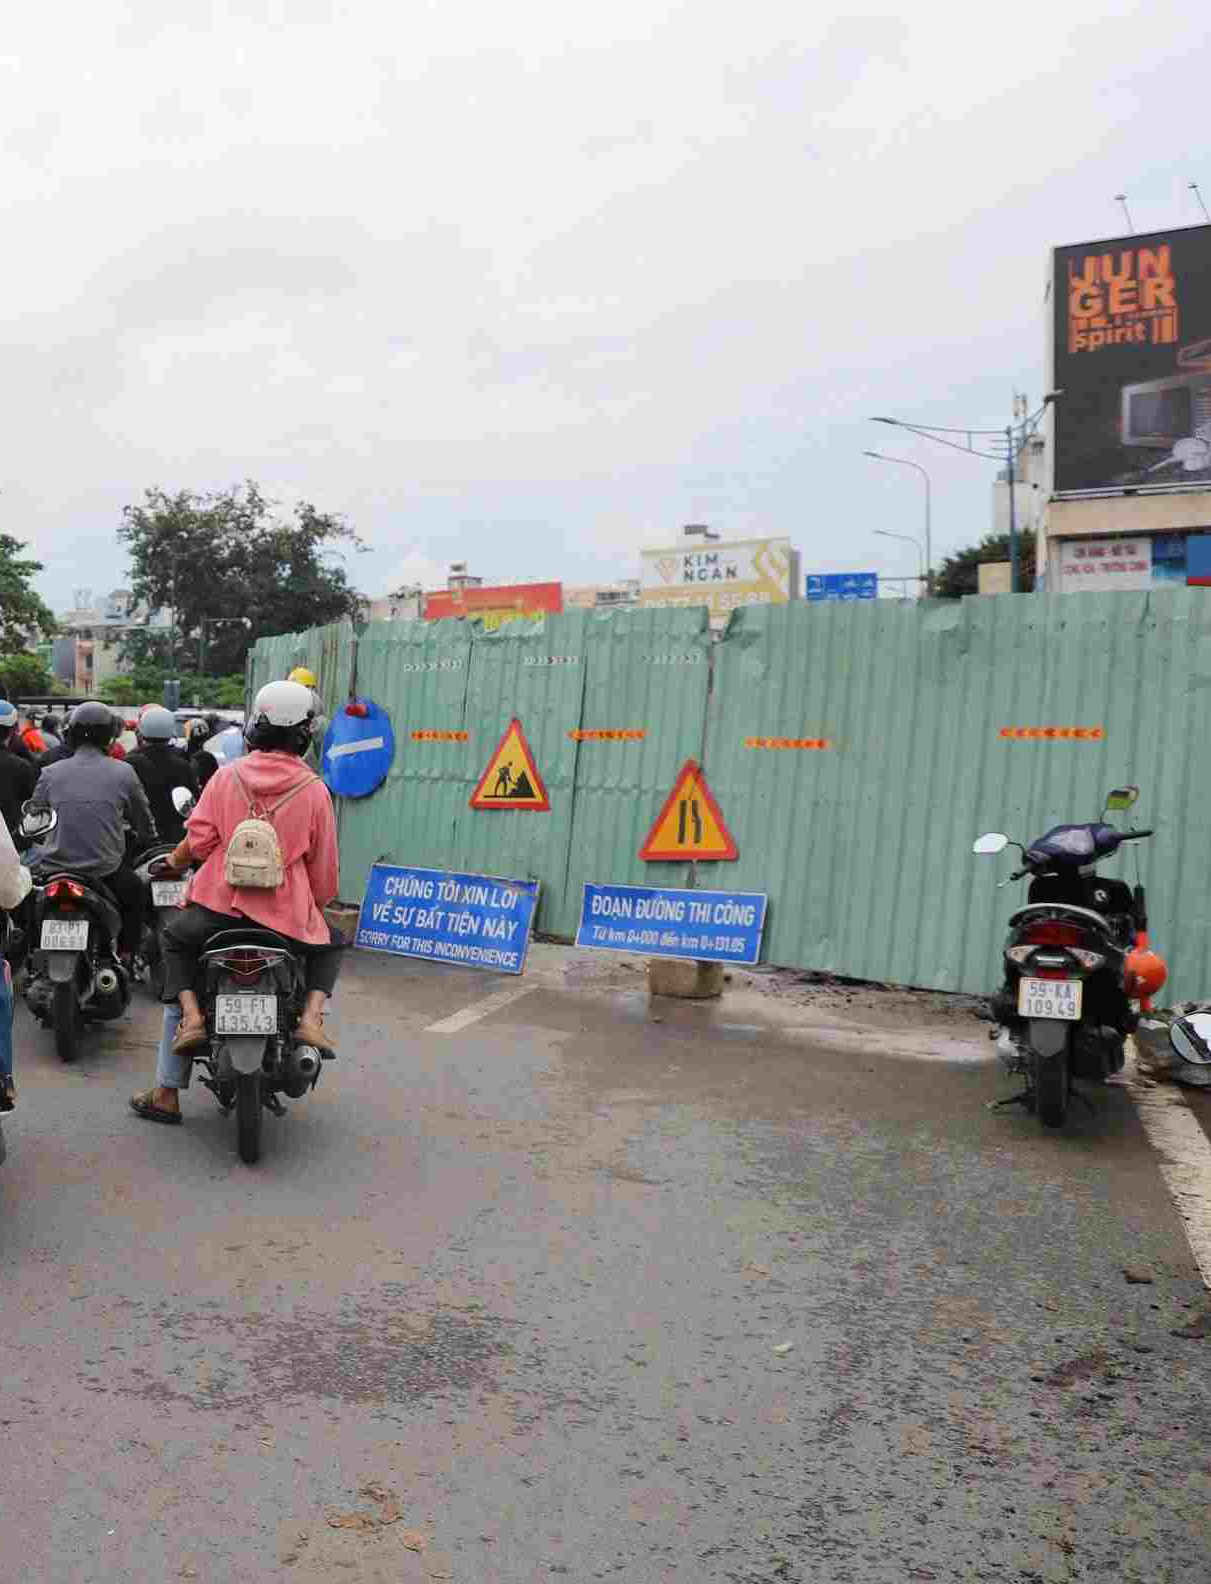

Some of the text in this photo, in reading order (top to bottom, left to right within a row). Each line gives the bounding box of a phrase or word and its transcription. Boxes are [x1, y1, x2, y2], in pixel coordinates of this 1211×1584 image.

[1069, 272, 1176, 317] GER
[683, 552, 719, 567] KIM
[384, 874, 434, 899] CHÚNG
[461, 885, 488, 906] XIN
[591, 895, 633, 919] ĐOẠN
[688, 902, 711, 924] THI
[713, 900, 756, 927] CÔNG
[359, 930, 519, 967] SORRY FOR THIS INCONVENIENCE
[608, 928, 626, 943] km
